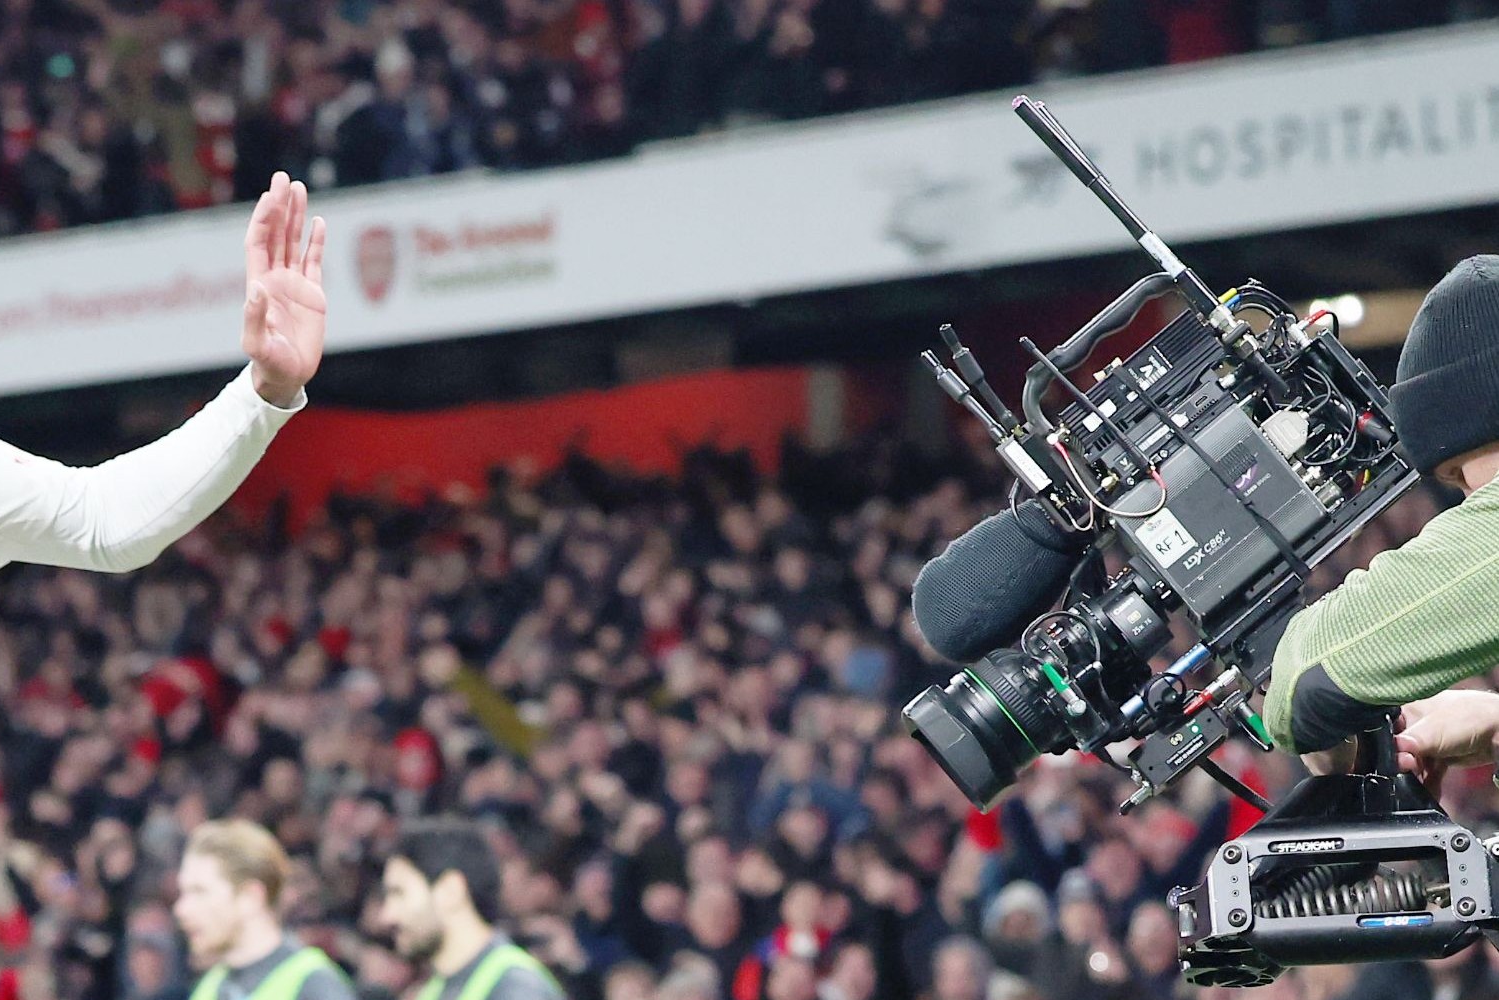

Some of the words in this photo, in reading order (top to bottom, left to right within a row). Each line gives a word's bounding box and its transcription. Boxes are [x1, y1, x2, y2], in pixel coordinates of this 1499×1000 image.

[1155, 536, 1173, 555] RF
[1174, 530, 1189, 546] 1
[1277, 840, 1336, 853] STEADICAM
